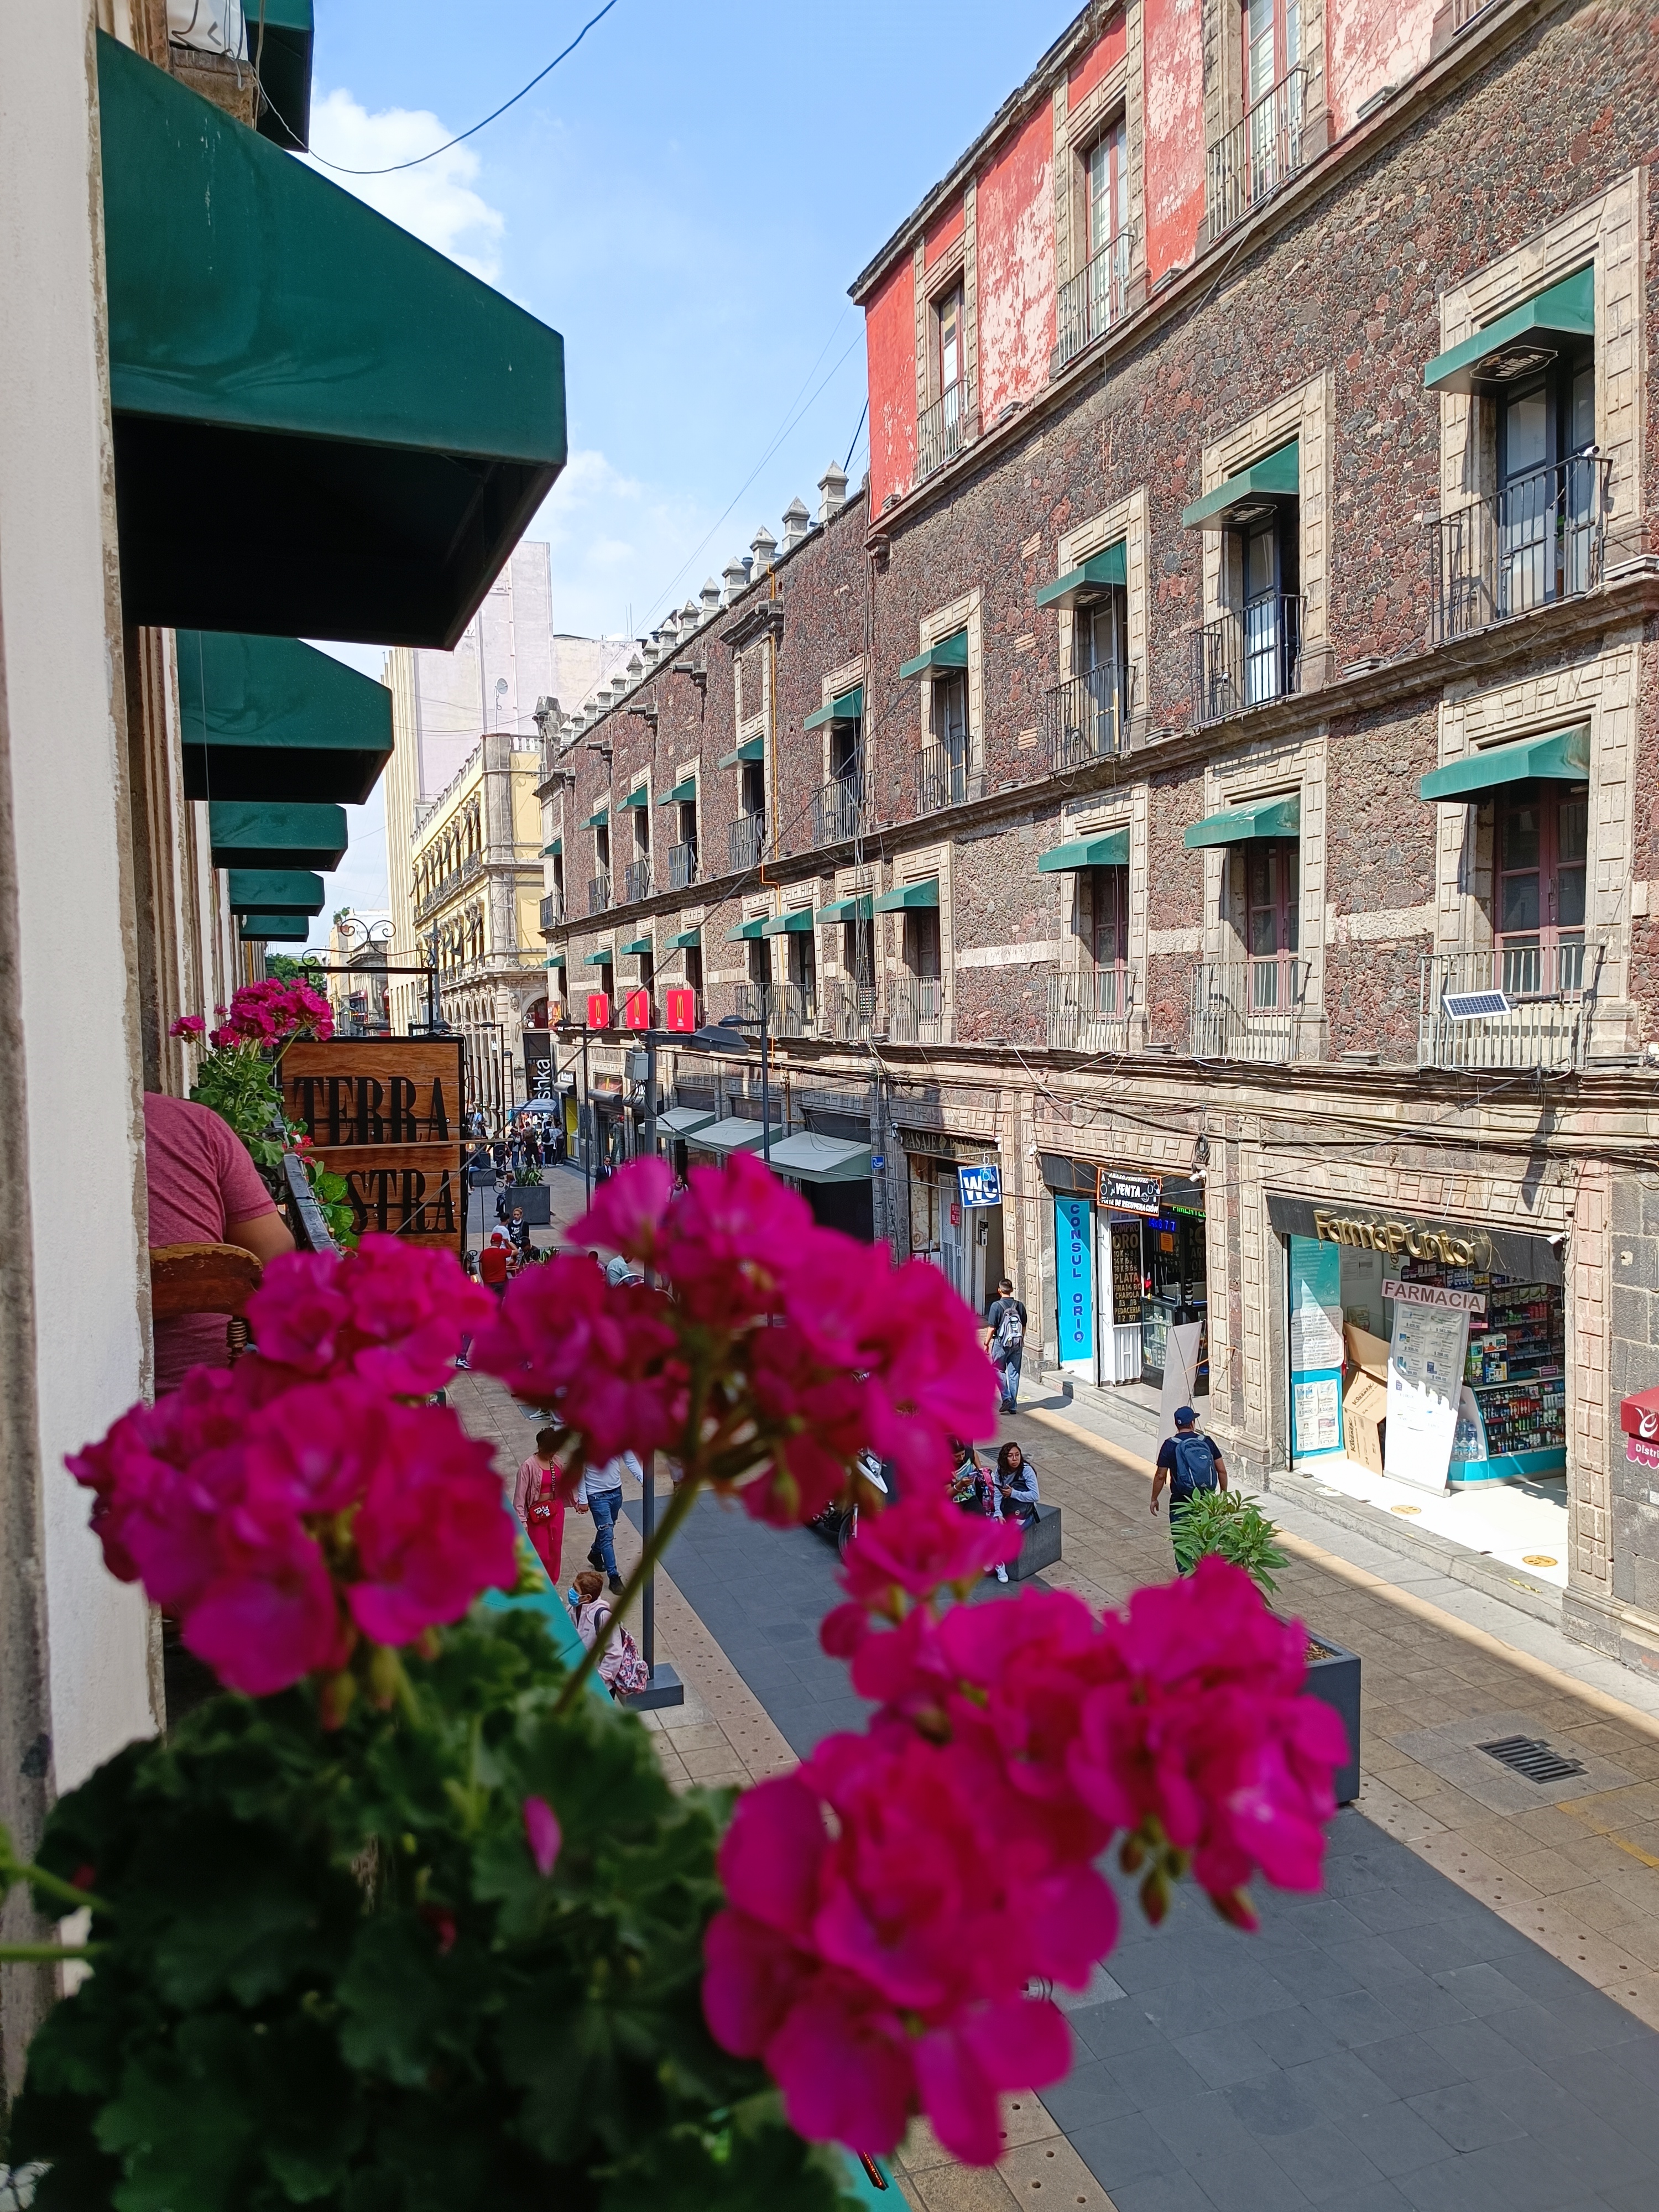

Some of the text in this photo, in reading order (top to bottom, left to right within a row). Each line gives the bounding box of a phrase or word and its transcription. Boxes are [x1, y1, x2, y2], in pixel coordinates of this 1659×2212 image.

[533, 1059, 551, 1099] shka
[294, 1076, 453, 1147] TERRA
[905, 1131, 1000, 1164] PASAJE PIMENTE
[963, 1168, 998, 1201] WC
[1115, 1182, 1141, 1198] VENTA
[345, 1169, 458, 1234] STRA
[1121, 1200, 1159, 1214] RECUPERACIÓN
[1112, 1222, 1139, 1234] COMPRO
[1313, 1209, 1475, 1266] FarmaPunto
[1113, 1234, 1139, 1250] ORO
[1114, 1272, 1139, 1284] PLATA
[1115, 1291, 1140, 1300] CHAROLA
[1384, 1281, 1481, 1311] FARMACIA
[1115, 1306, 1141, 1315] PEDACERIA
[1352, 1382, 1374, 1405] Kleenex
